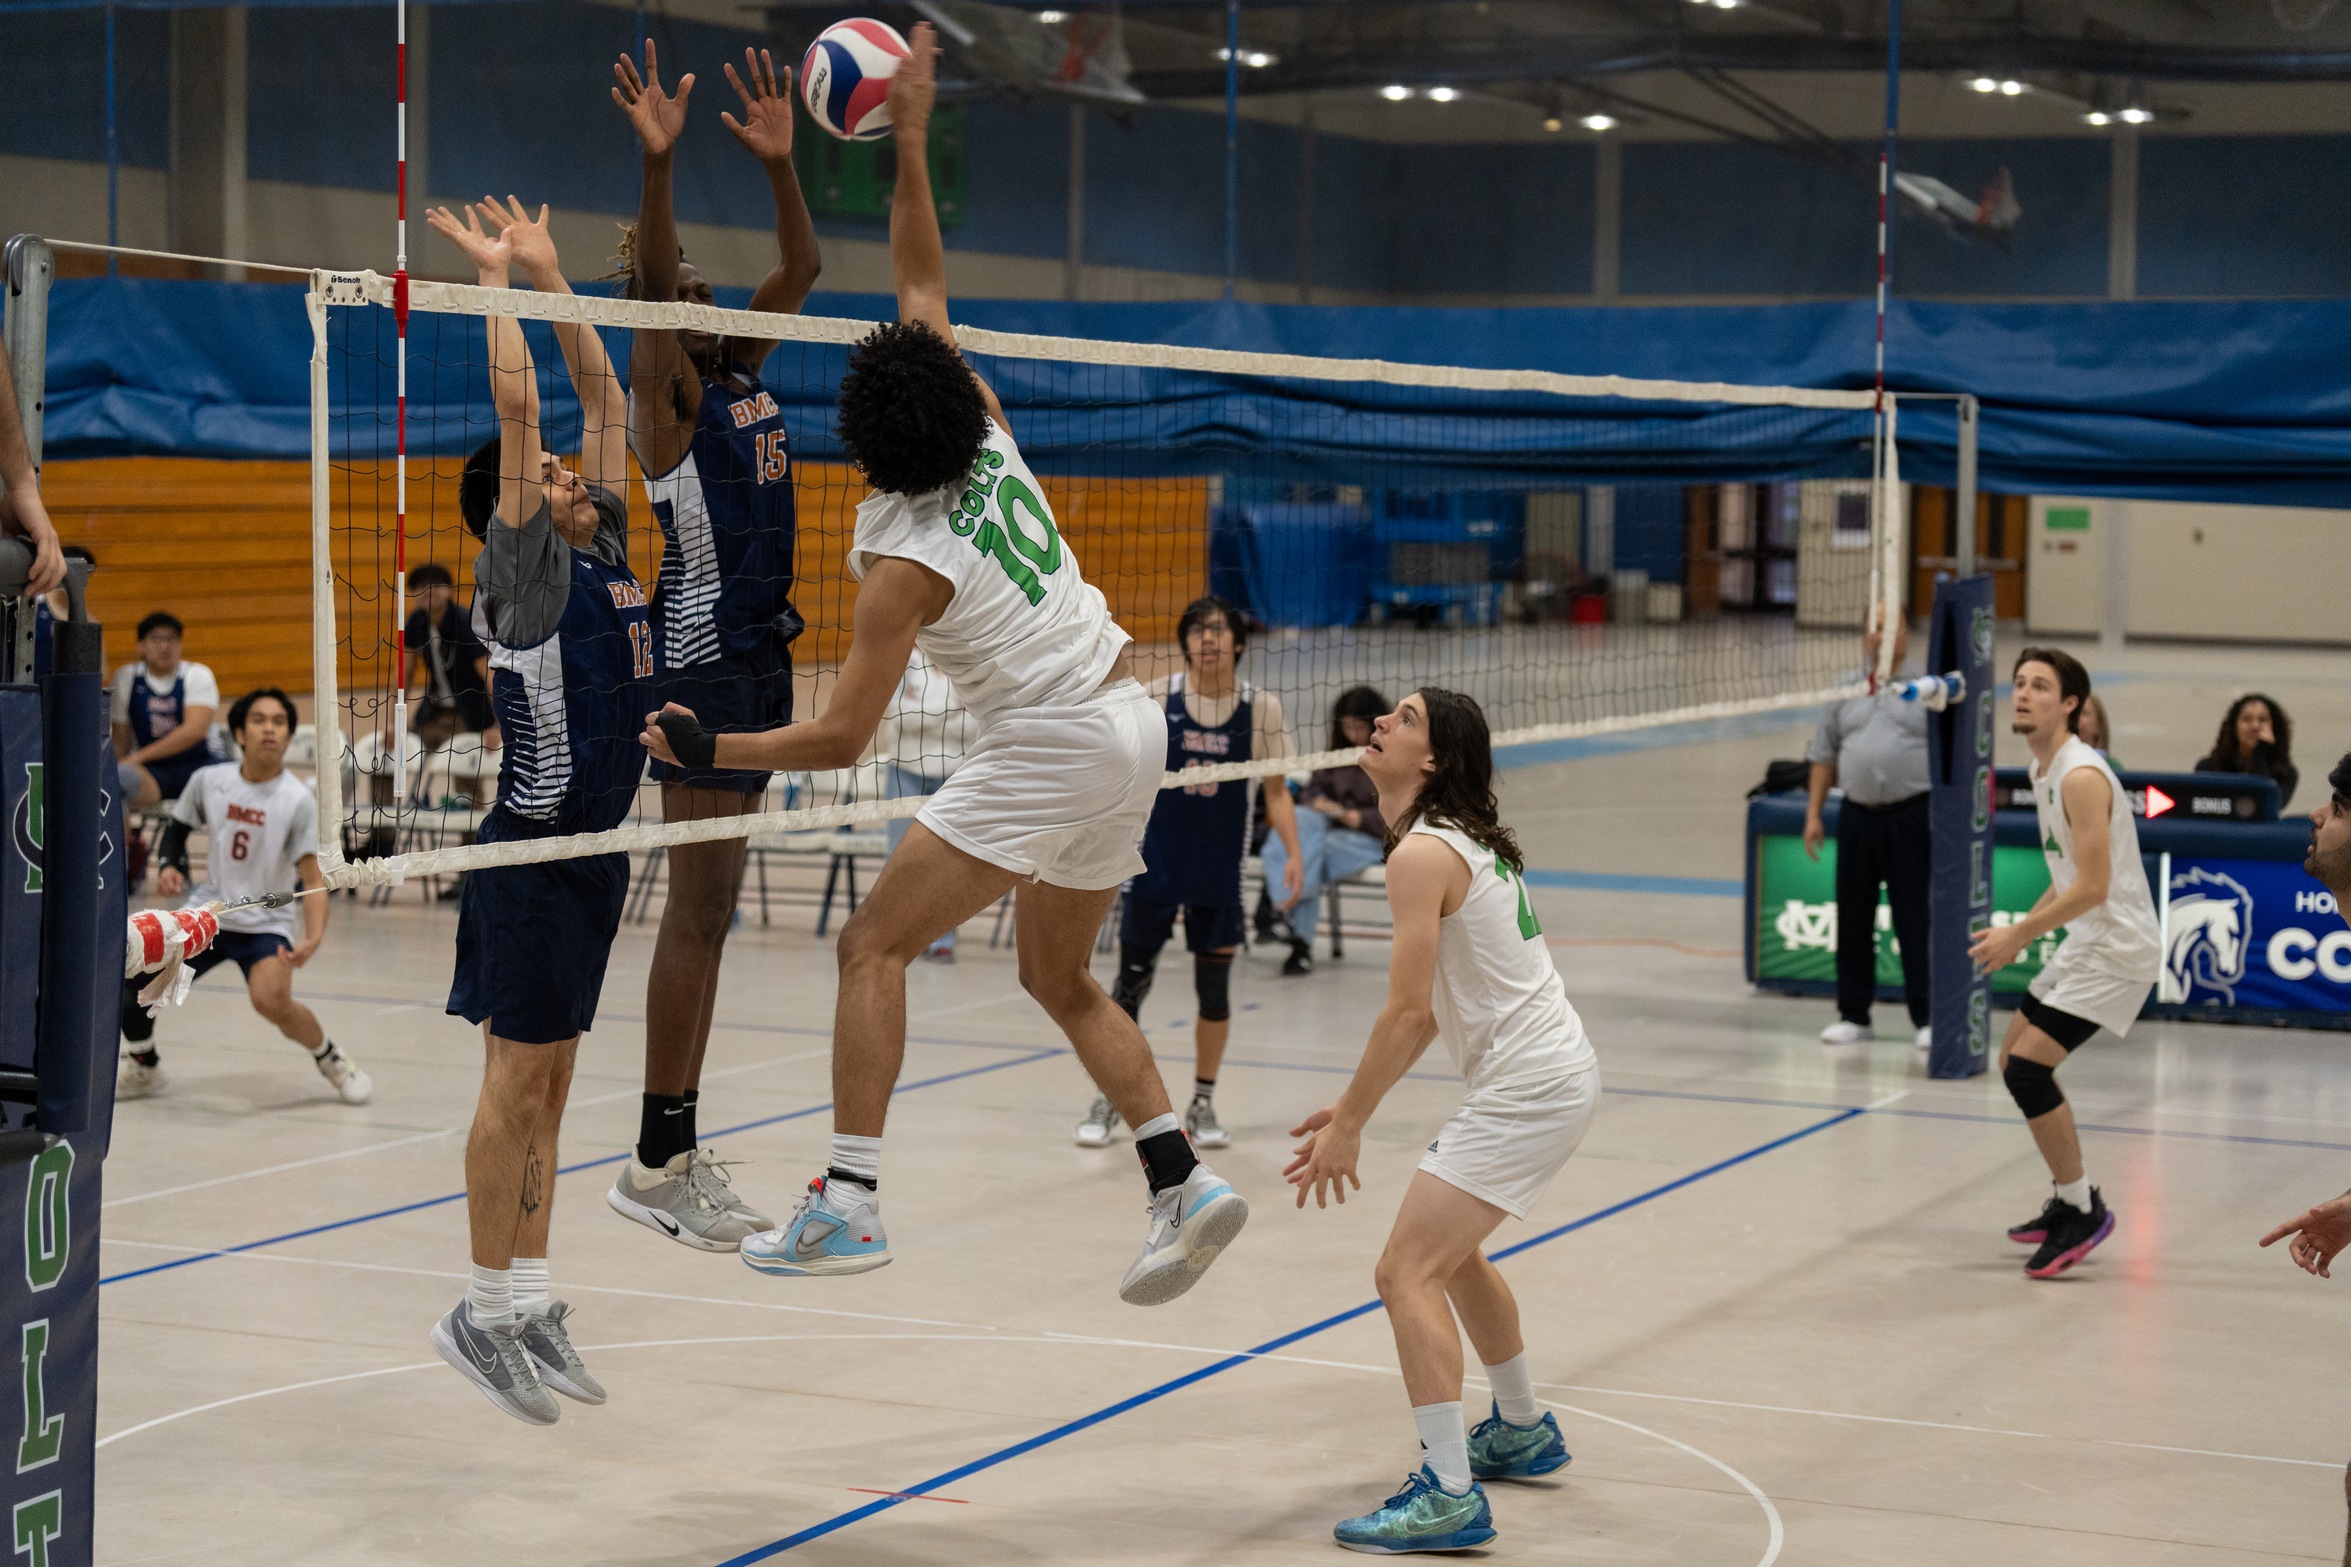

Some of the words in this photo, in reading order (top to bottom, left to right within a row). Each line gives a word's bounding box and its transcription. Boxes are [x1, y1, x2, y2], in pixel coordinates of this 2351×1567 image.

[727, 391, 779, 428] BMC
[755, 429, 787, 485] 15
[948, 448, 1005, 538] COLTS
[972, 475, 1062, 607] 10
[606, 578, 647, 609] BM
[628, 620, 654, 679] 12
[231, 830, 250, 862] 6
